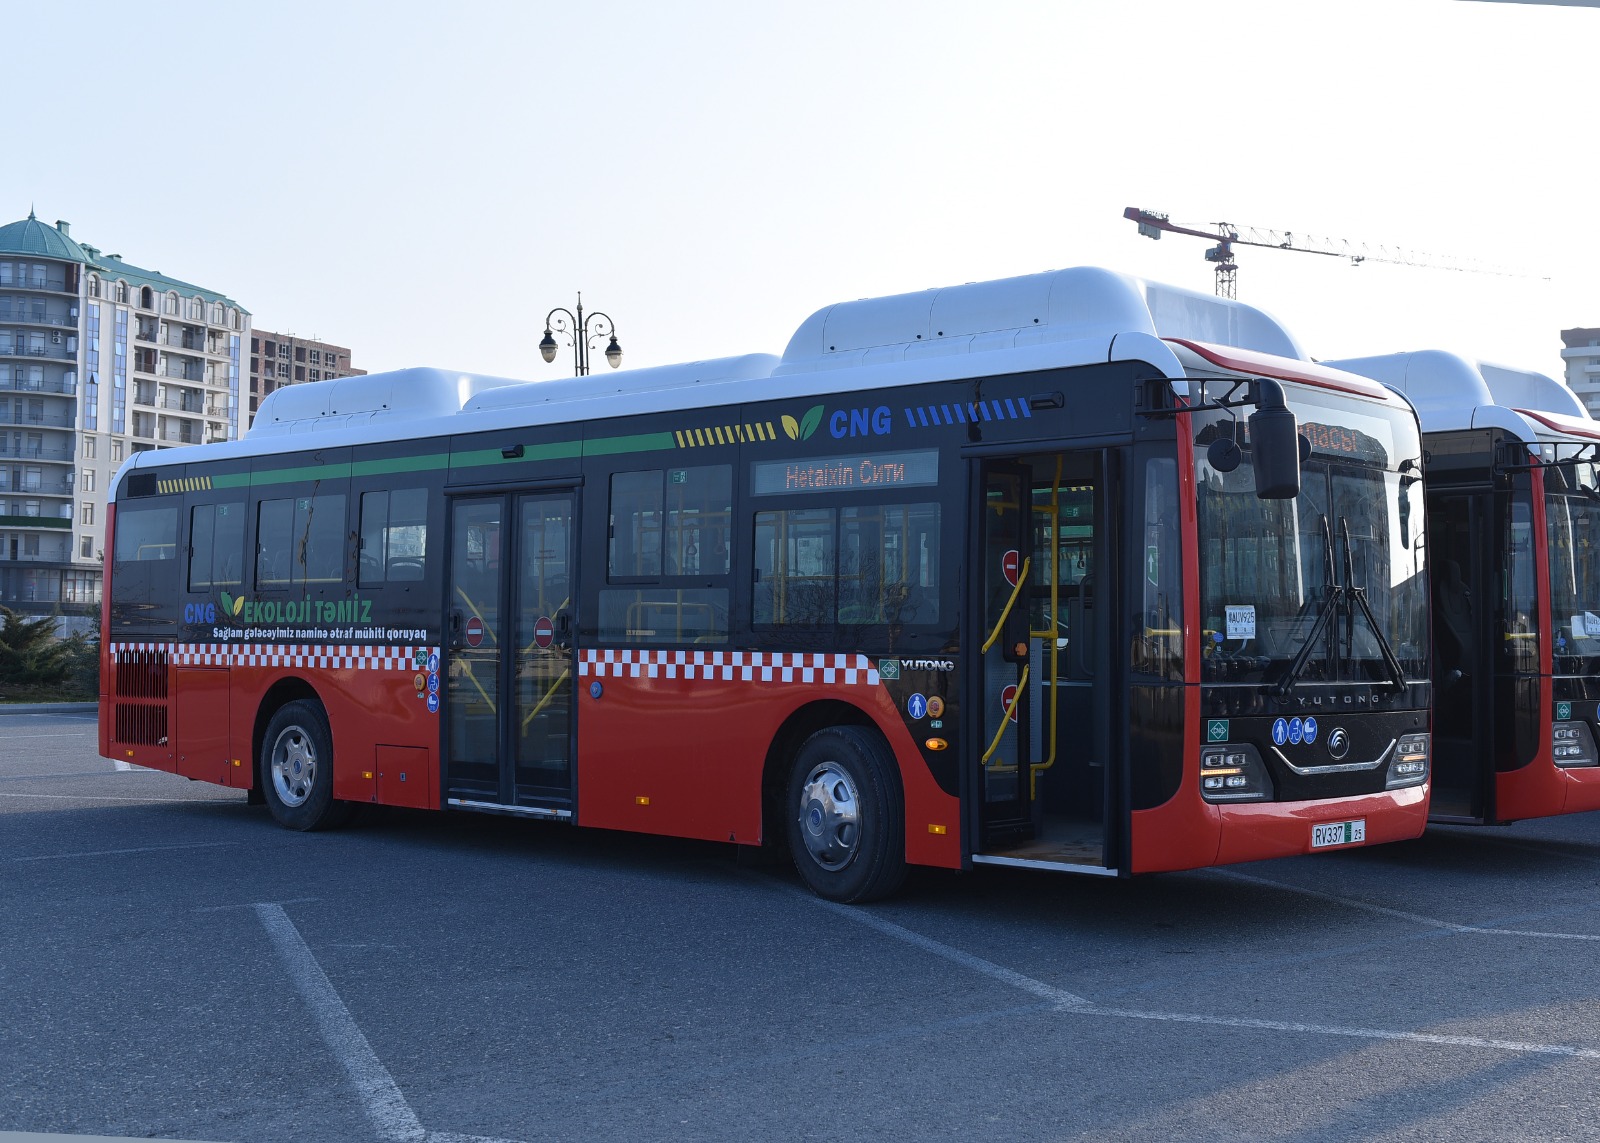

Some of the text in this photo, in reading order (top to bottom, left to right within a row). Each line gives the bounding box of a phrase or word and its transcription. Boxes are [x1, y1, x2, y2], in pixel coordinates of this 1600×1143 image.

[830, 405, 891, 439] CNG
[184, 603, 216, 624] CNG
[243, 594, 311, 623] EKOLOJİ
[213, 626, 243, 641] Sağlam
[295, 626, 328, 639] naminə
[329, 627, 354, 639] ətraf
[354, 626, 385, 640] mühiti
[386, 628, 427, 642] qoruyaq
[901, 660, 955, 672] YUTONG
[1297, 694, 1379, 705] YUTONG
[1315, 826, 1343, 845] RV337
[1354, 828, 1362, 840] 25
